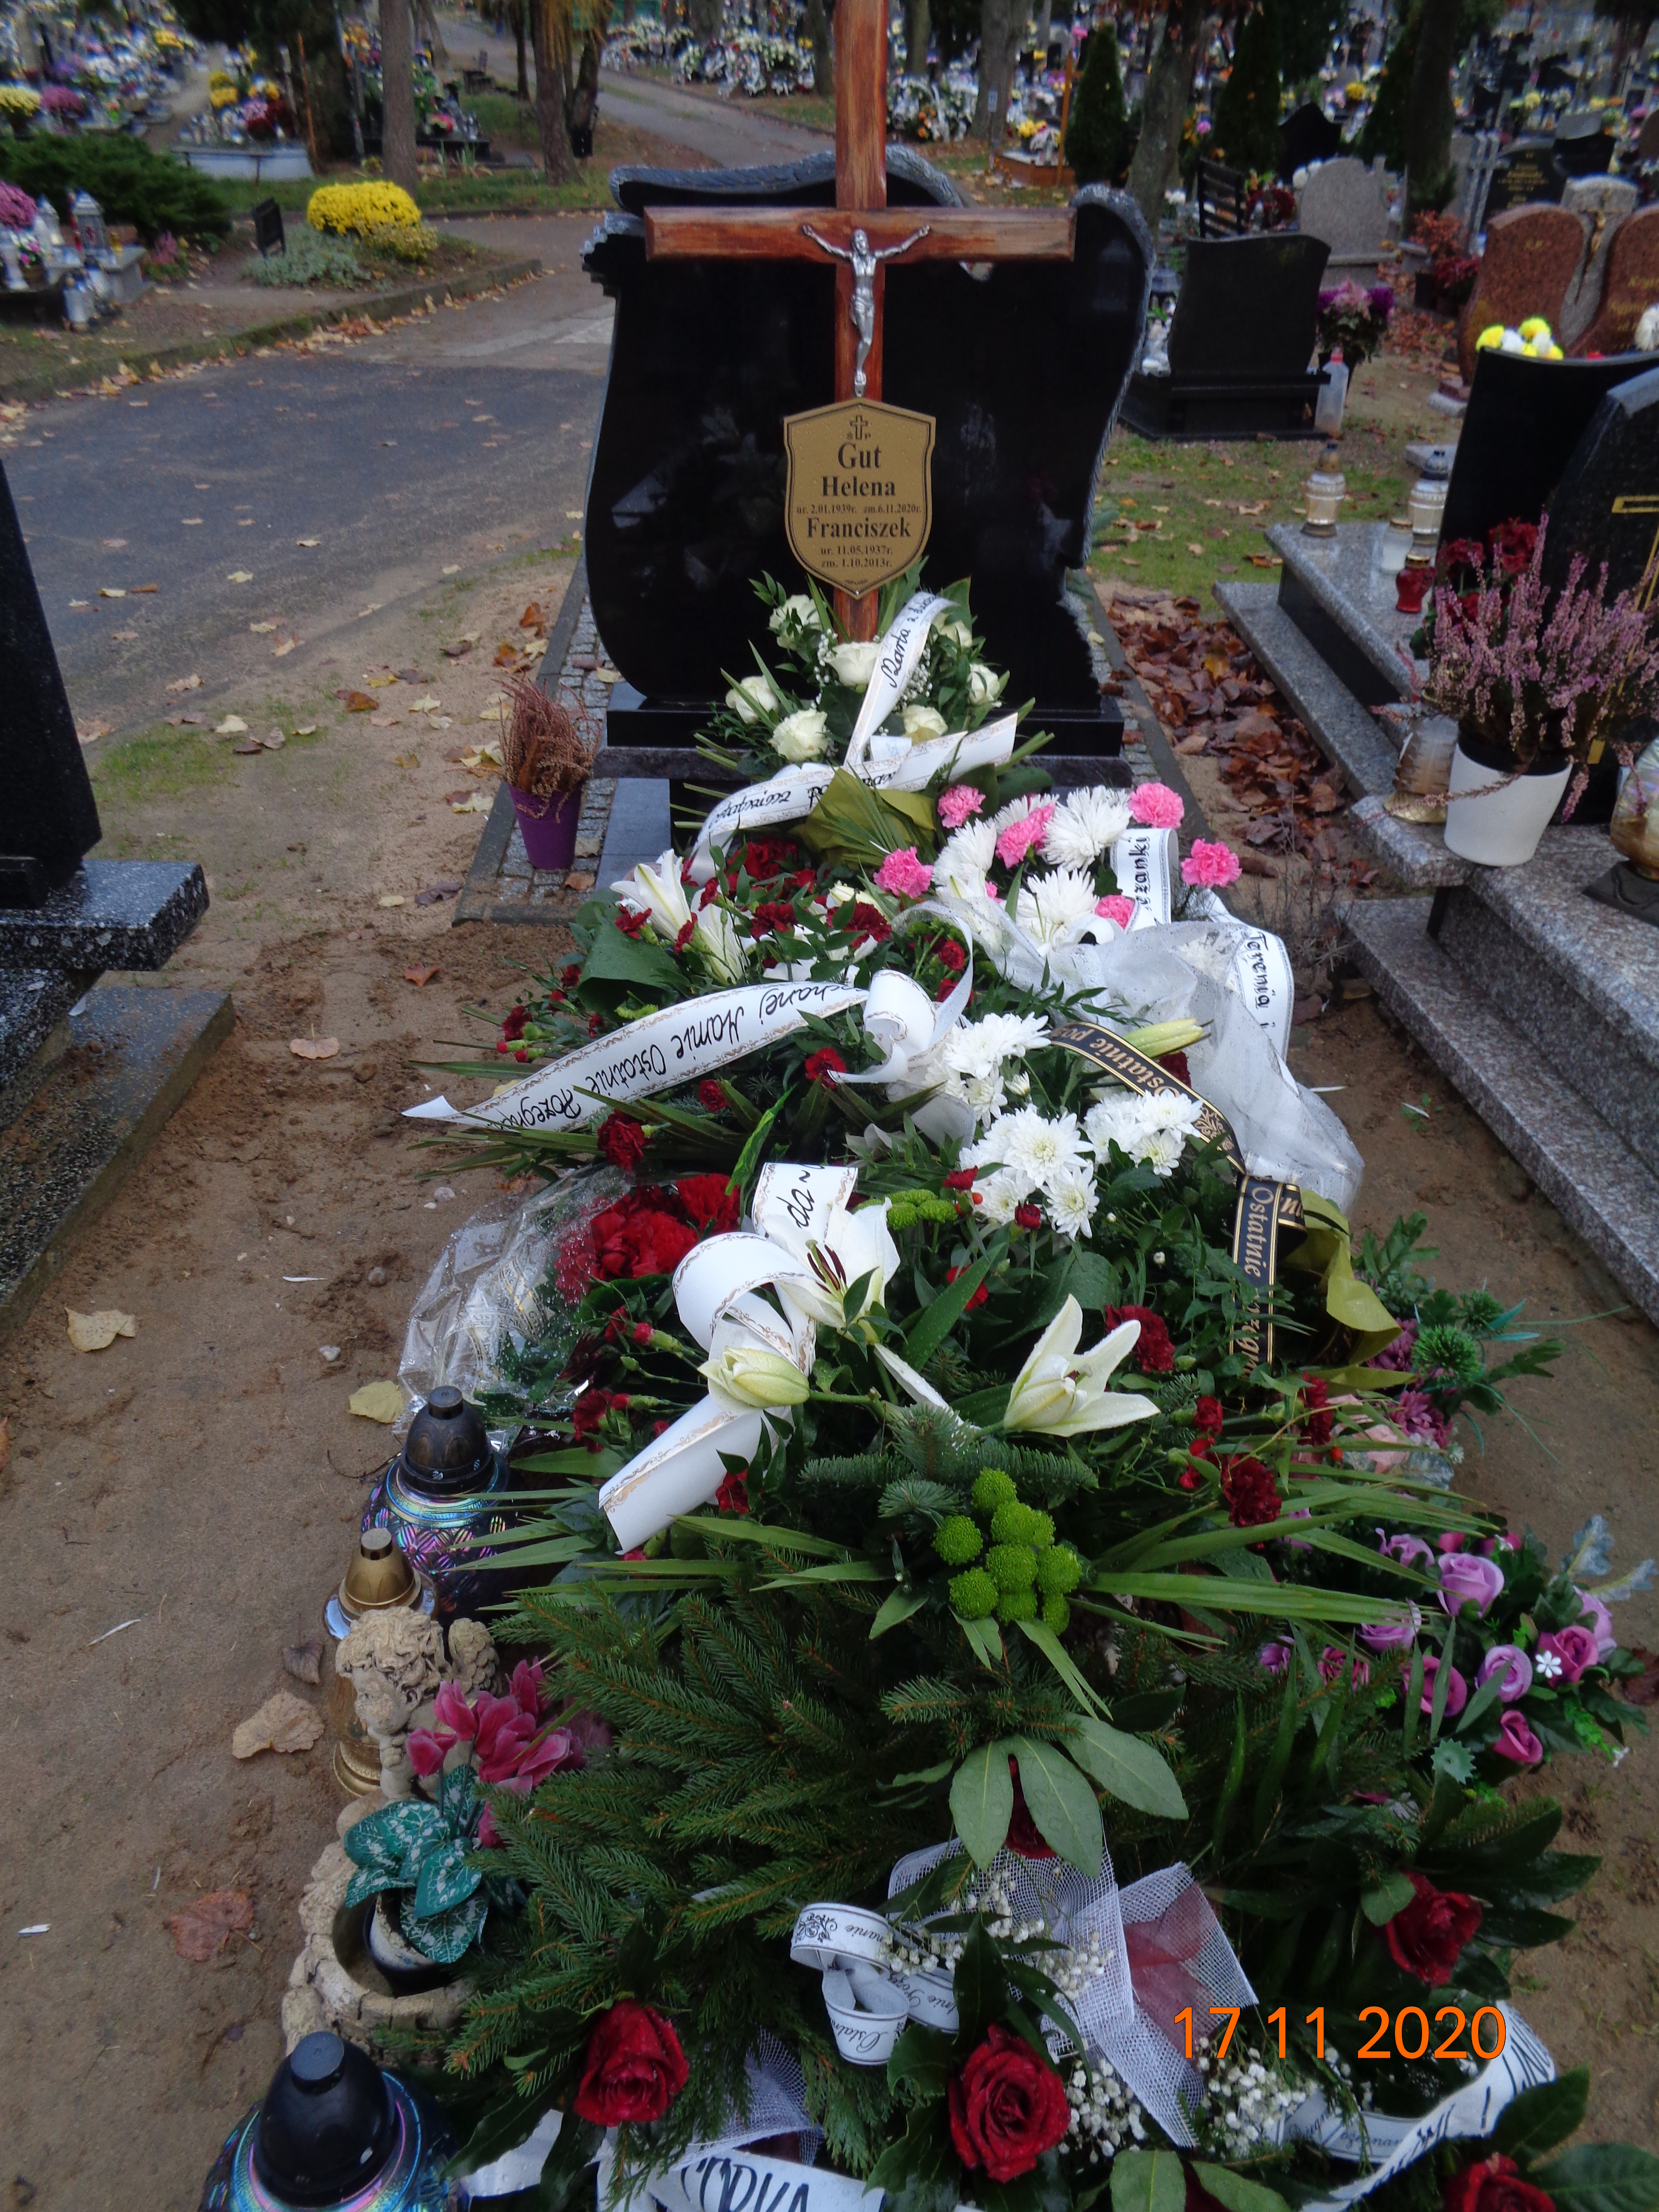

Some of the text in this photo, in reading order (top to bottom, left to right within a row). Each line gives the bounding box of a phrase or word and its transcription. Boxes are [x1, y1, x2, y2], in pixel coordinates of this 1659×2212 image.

[837, 442, 881, 469] Gut
[822, 475, 896, 497] Helena
[796, 506, 808, 514] ur.
[807, 517, 911, 538] Franciszek
[881, 629, 911, 688] Marta
[1245, 931, 1275, 1009] Terenia
[583, 1041, 668, 1094] Ostatnie
[776, 1188, 816, 1229] da
[1244, 1186, 1274, 1278] Ostatnie
[829, 2018, 889, 2054] Ostatn
